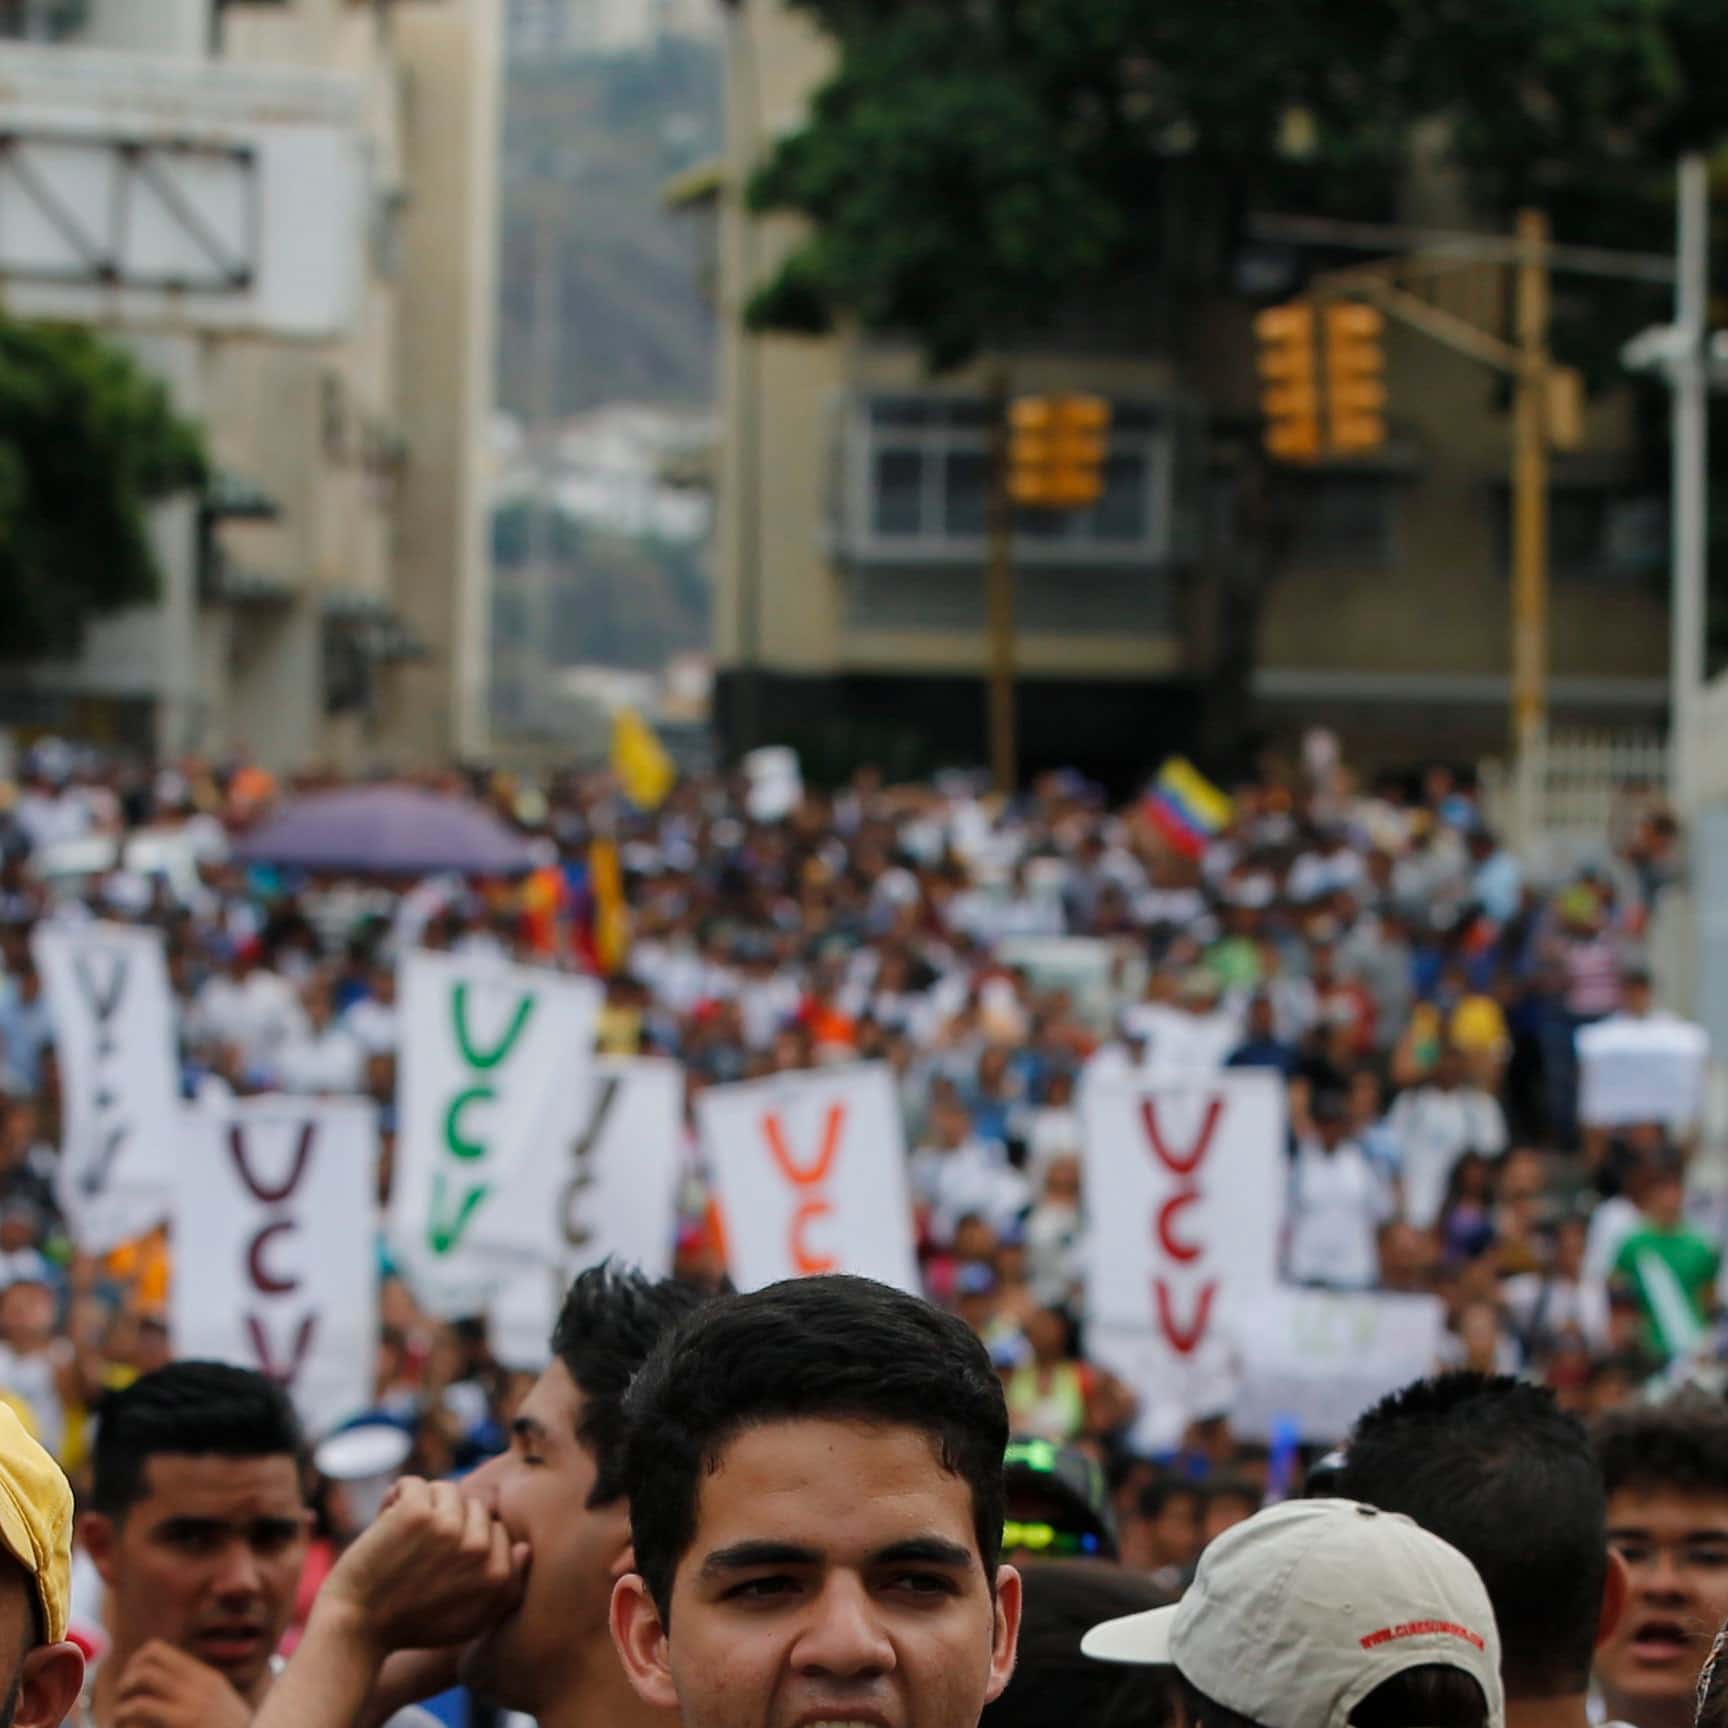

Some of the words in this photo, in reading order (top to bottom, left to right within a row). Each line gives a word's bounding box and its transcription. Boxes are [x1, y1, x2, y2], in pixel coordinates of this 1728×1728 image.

[425, 980, 537, 1258] UCV
[1139, 1096, 1226, 1355] UCV
[229, 1122, 321, 1384] UCV
